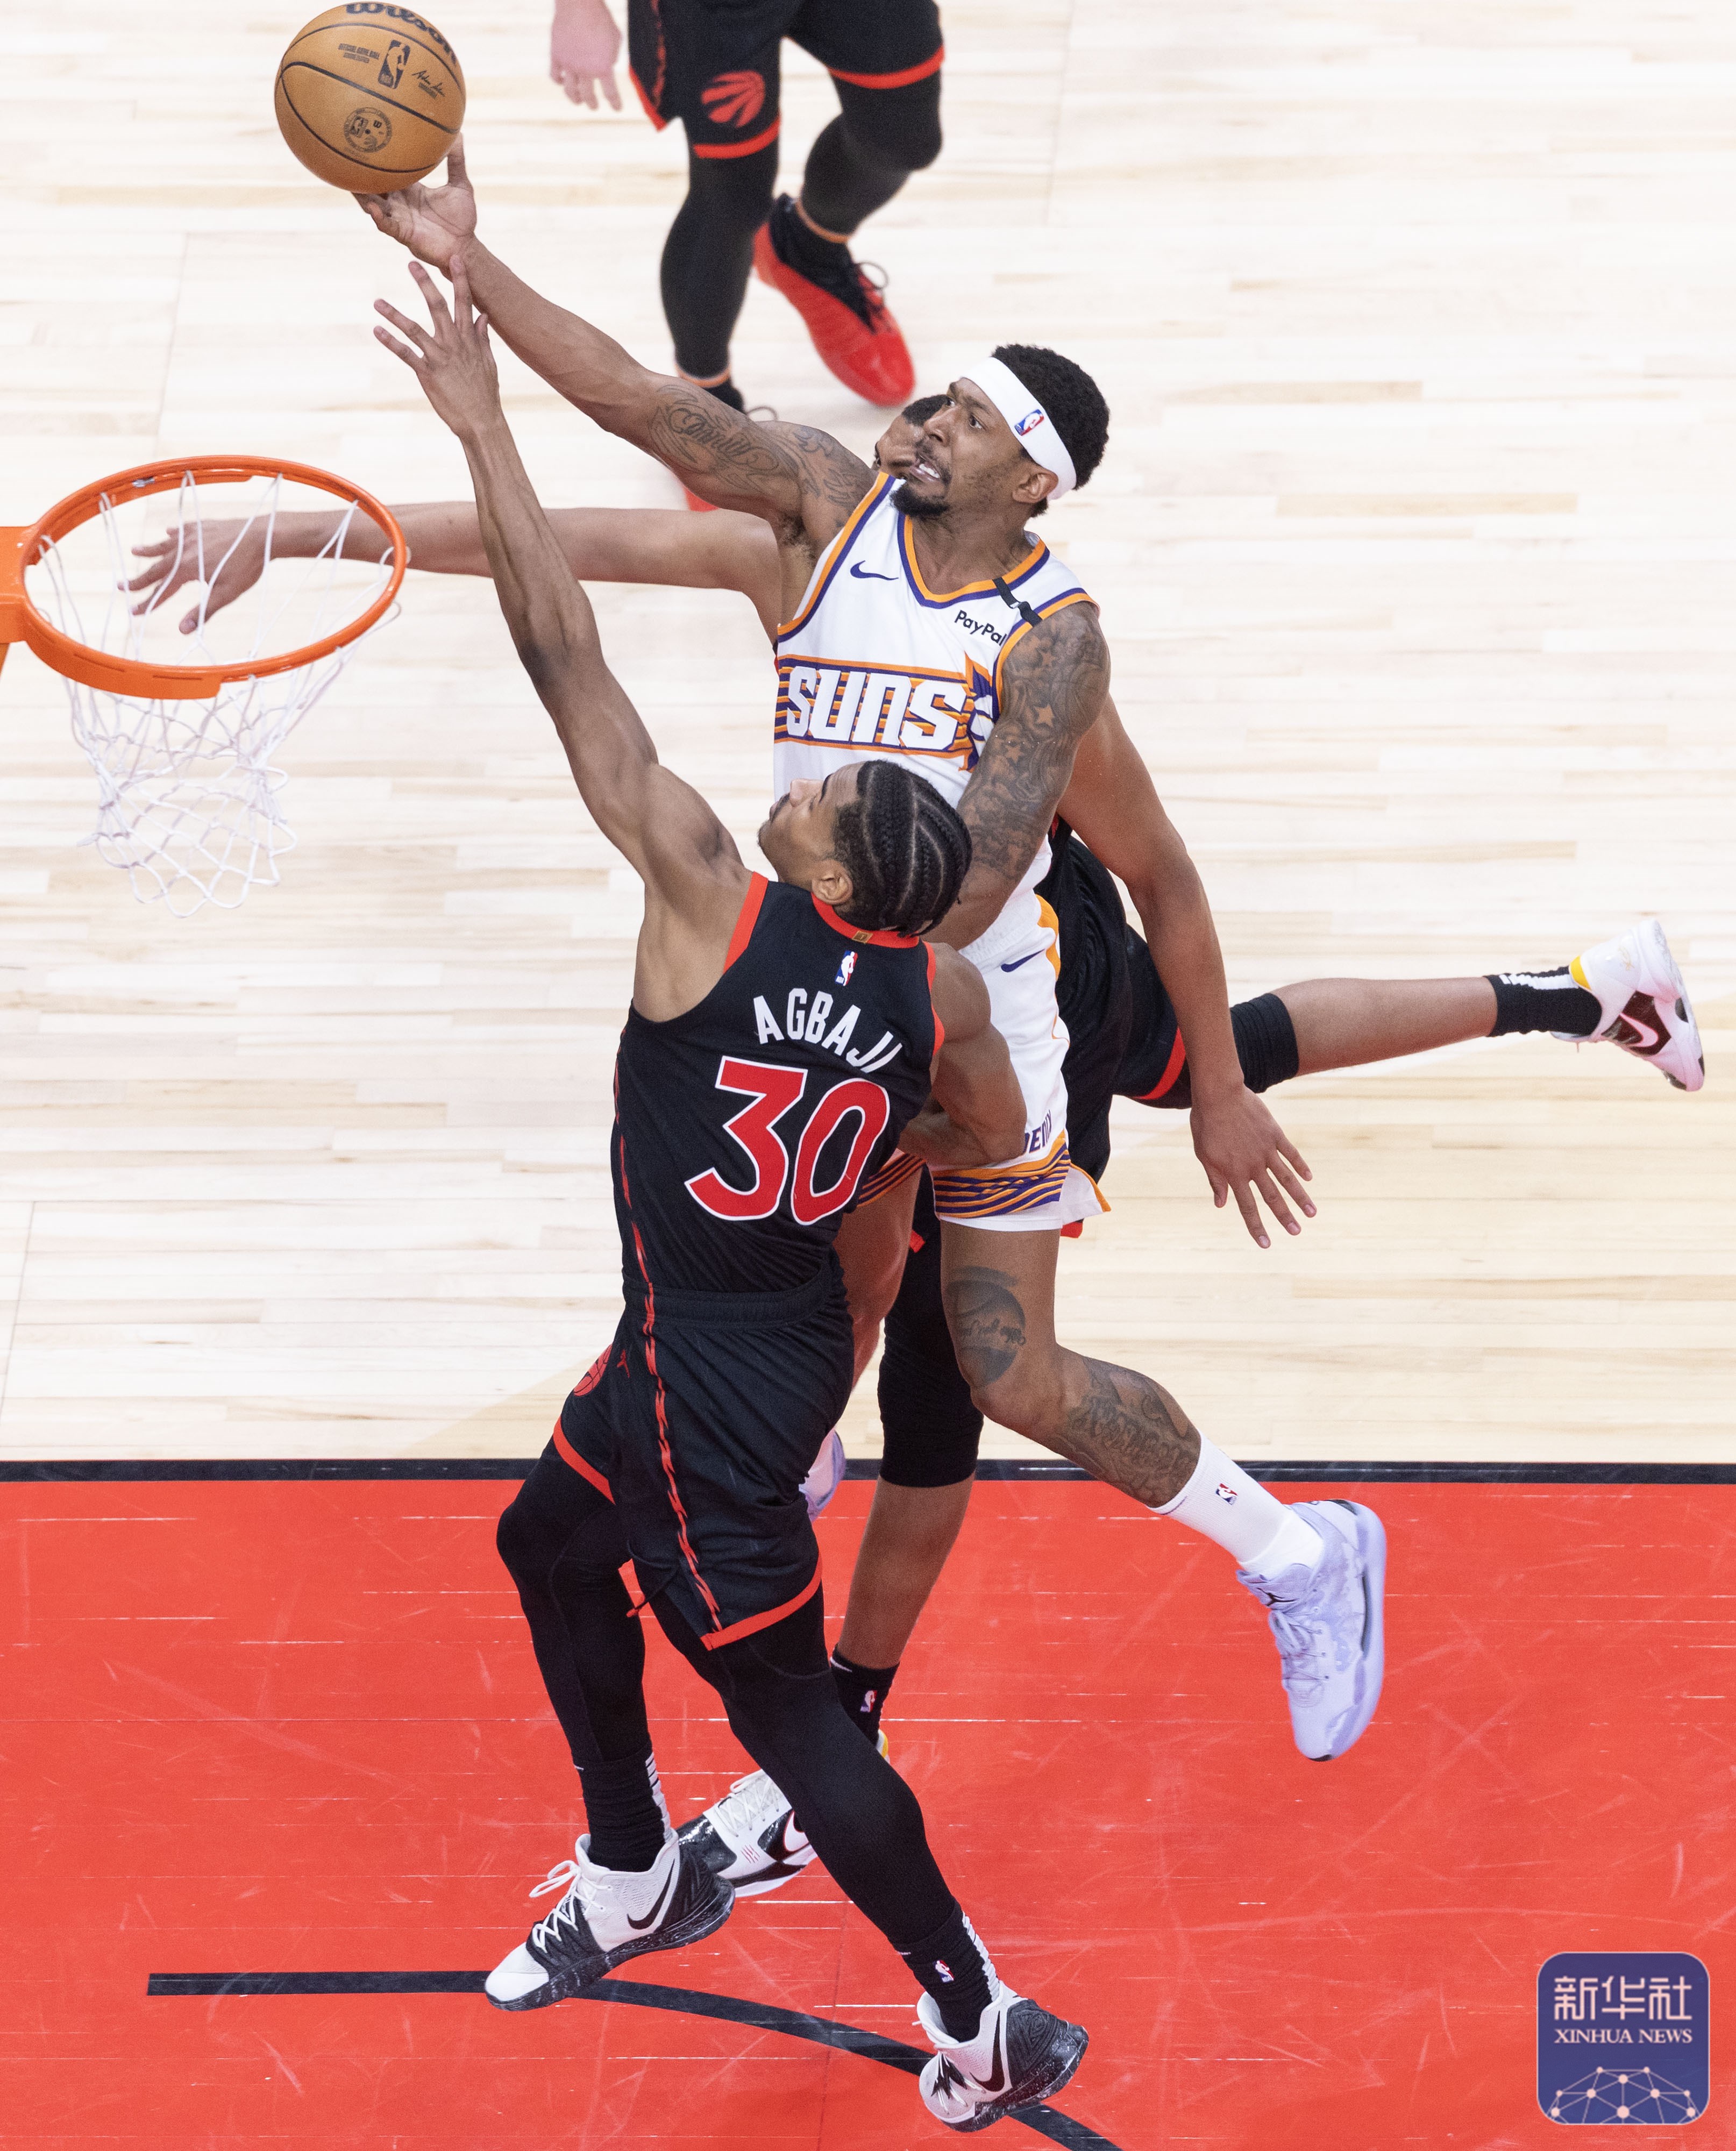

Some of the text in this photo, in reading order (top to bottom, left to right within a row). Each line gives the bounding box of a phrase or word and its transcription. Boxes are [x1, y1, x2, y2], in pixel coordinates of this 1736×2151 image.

[954, 609, 1007, 646] PayPal
[787, 666, 967, 750] SUNS
[753, 987, 902, 1073] AGBAJI
[684, 1056, 890, 1226] 30
